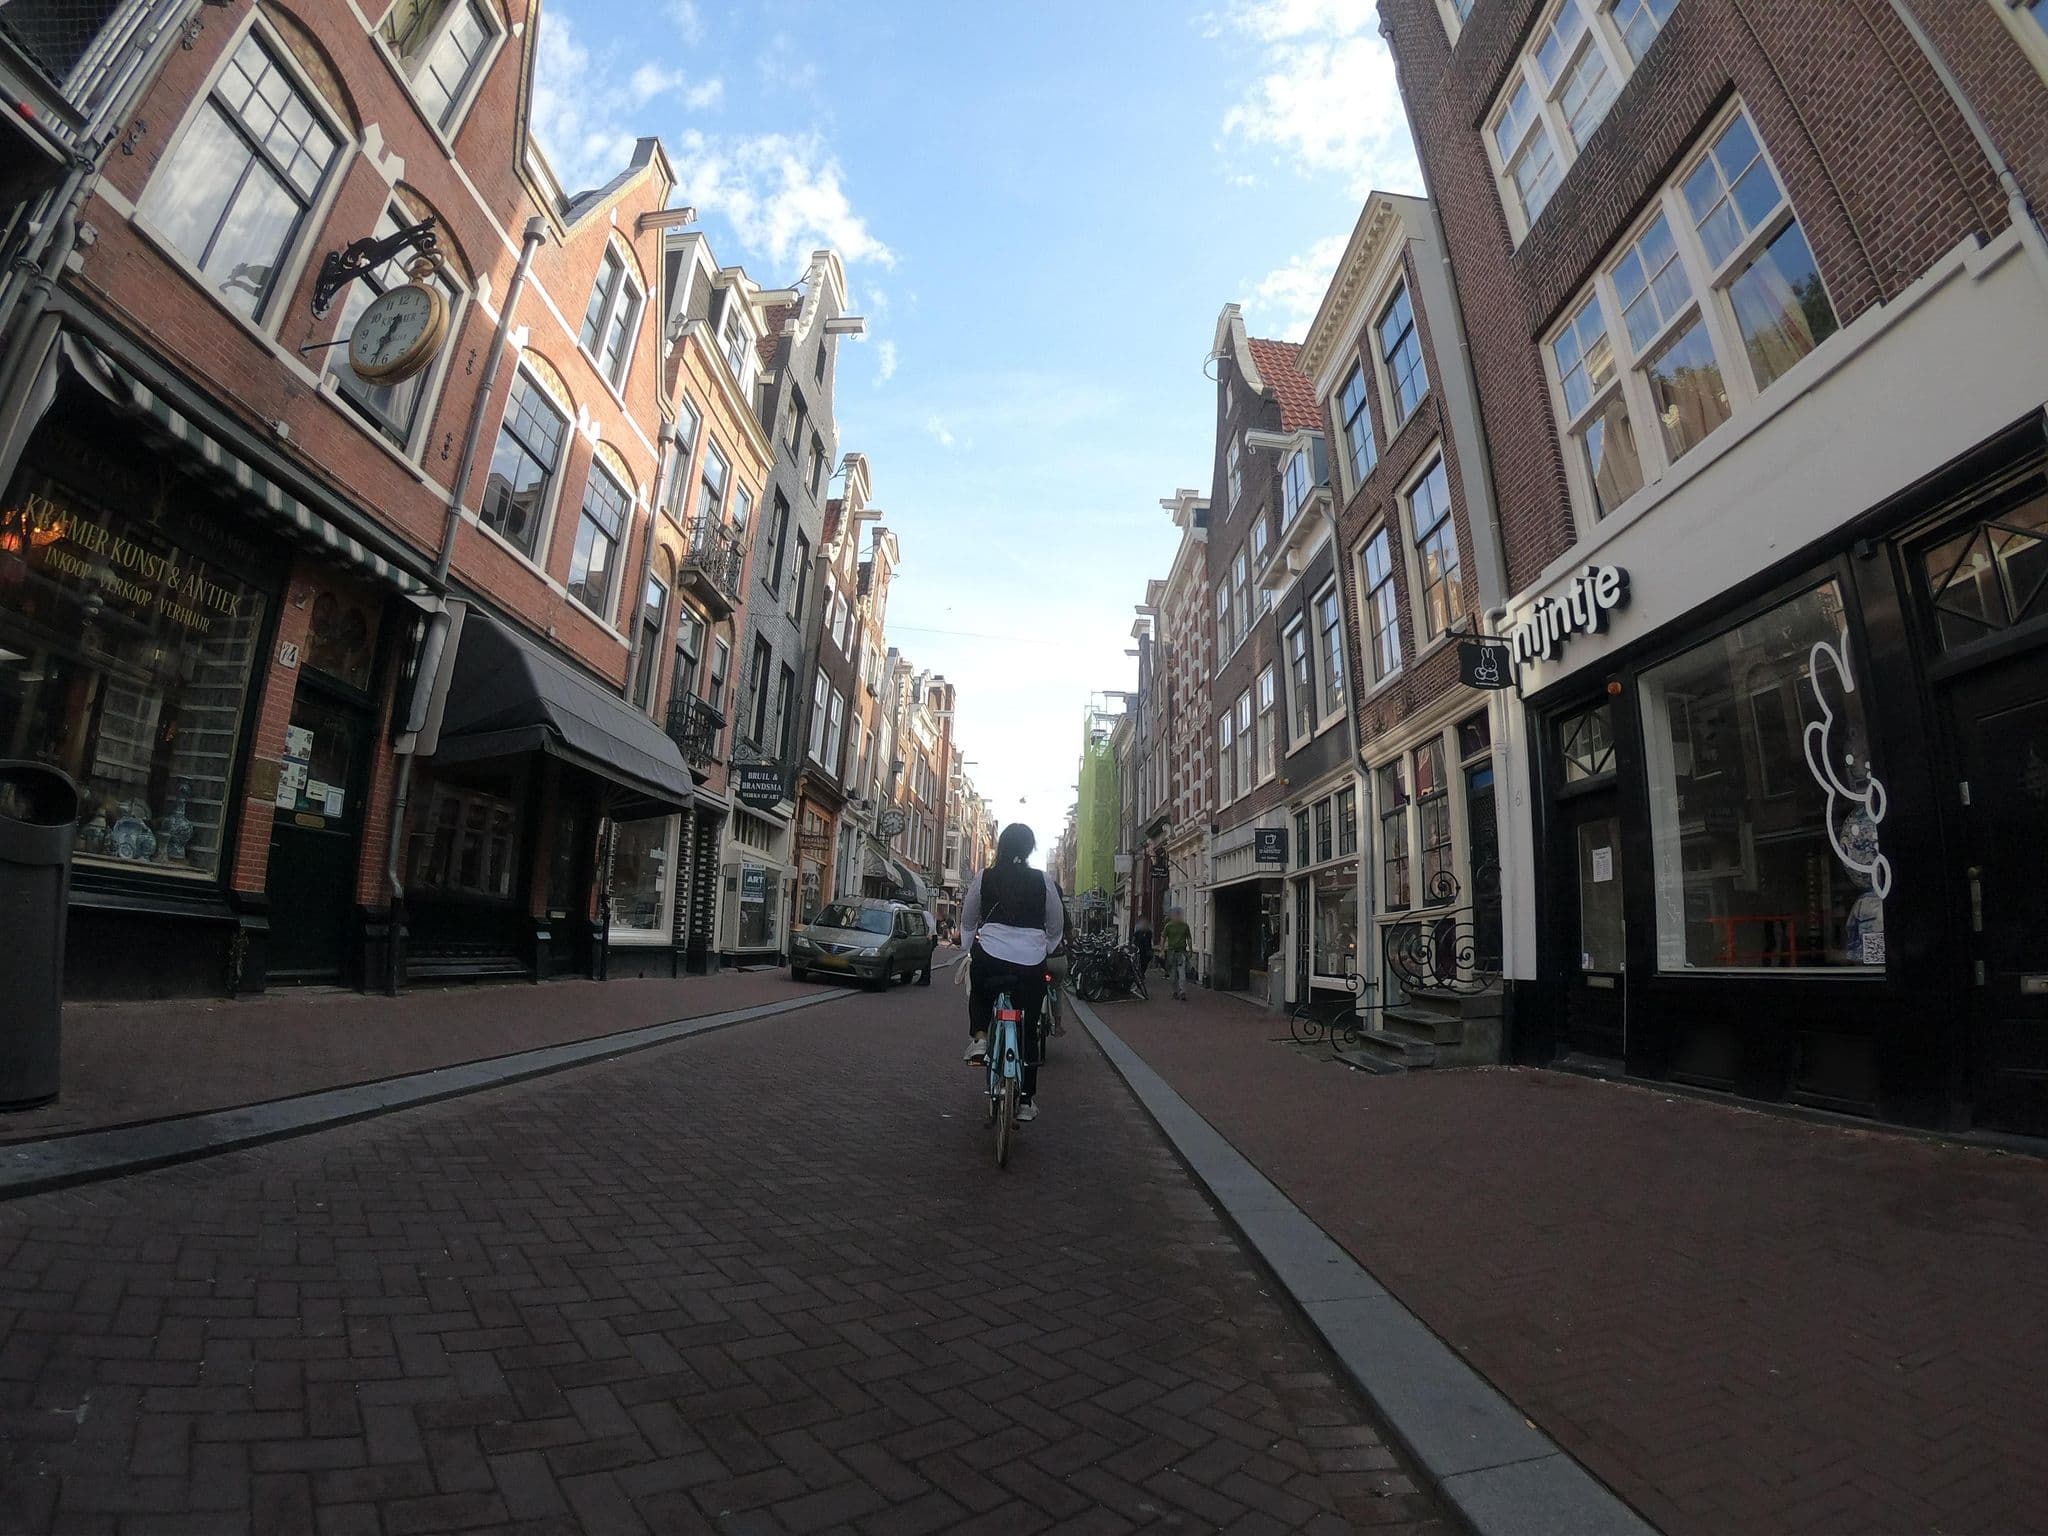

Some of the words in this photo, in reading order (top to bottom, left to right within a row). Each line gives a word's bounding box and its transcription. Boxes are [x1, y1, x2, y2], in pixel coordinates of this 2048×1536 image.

[44, 546, 93, 580] INKOOP
[99, 575, 152, 607] VERKOOP
[159, 597, 211, 633] VERHUUR
[111, 536, 170, 583] KUNST
[168, 566, 181, 589] &
[182, 573, 242, 618] ANTIEK
[1512, 565, 1626, 664] nijntje
[741, 781, 783, 792] BRANDSMA
[747, 771, 771, 781] BRUIL
[772, 773, 779, 781] &
[747, 875, 765, 884] ART
